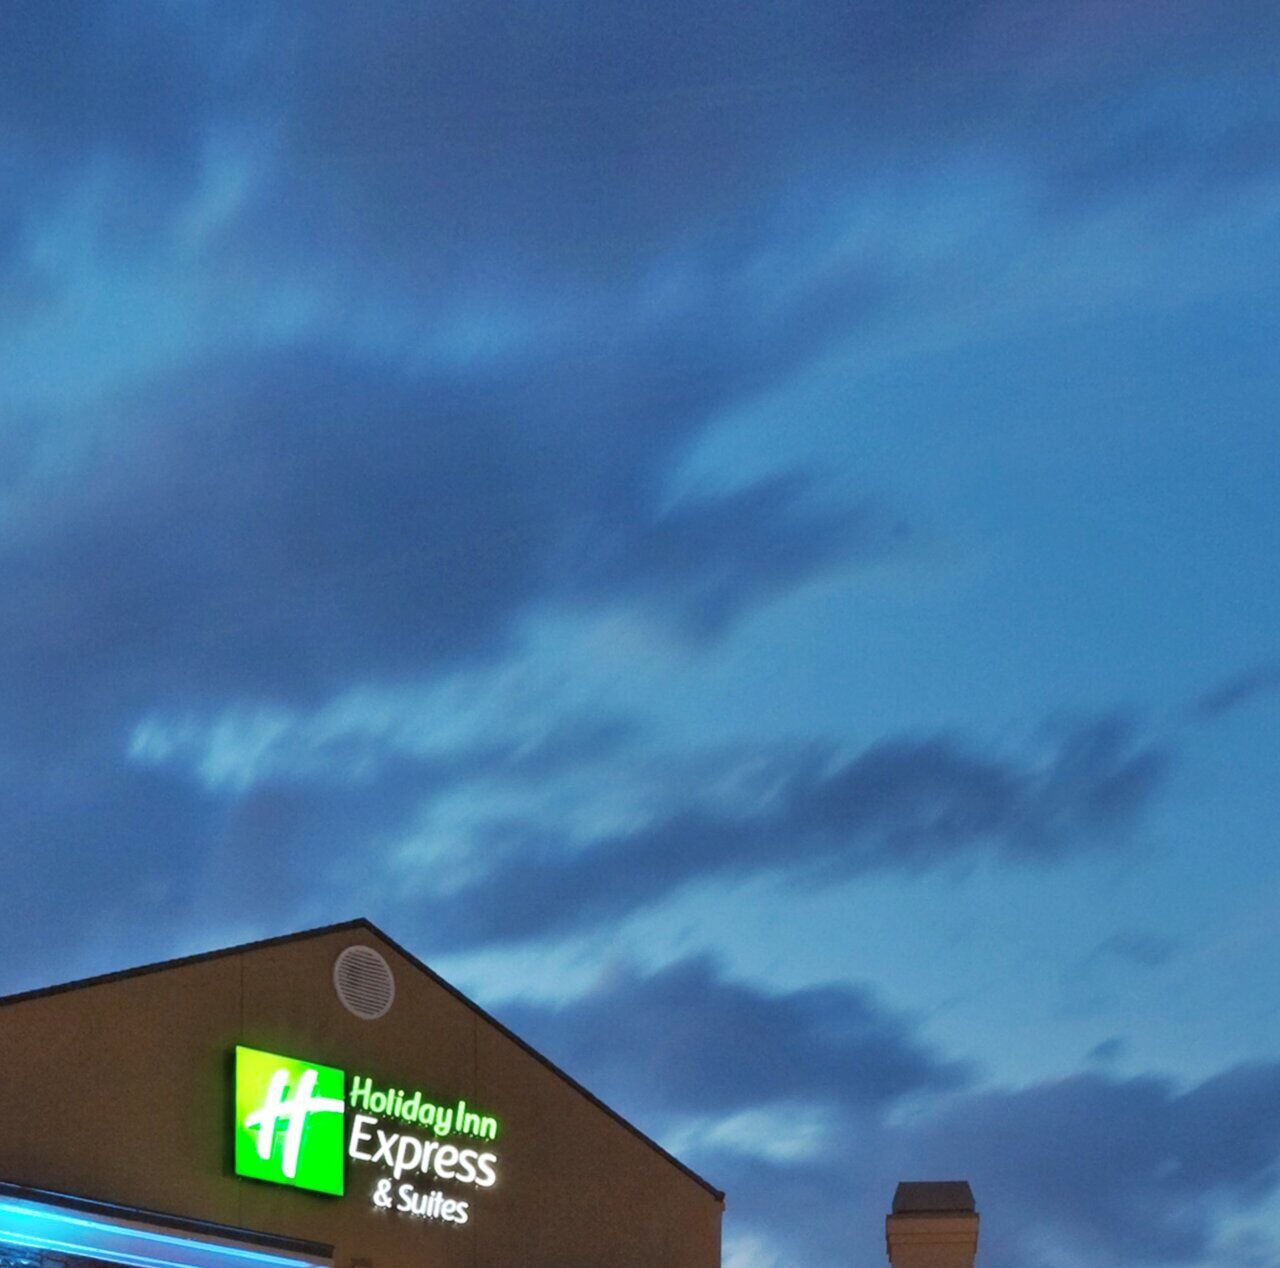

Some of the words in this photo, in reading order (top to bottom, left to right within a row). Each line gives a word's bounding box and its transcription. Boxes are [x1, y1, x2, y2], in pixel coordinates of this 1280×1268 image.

[350, 1076, 453, 1137] Holiday
[456, 1101, 497, 1140] Inn
[349, 1115, 497, 1187] Express
[373, 1179, 393, 1208] &
[397, 1184, 469, 1224] Suites
